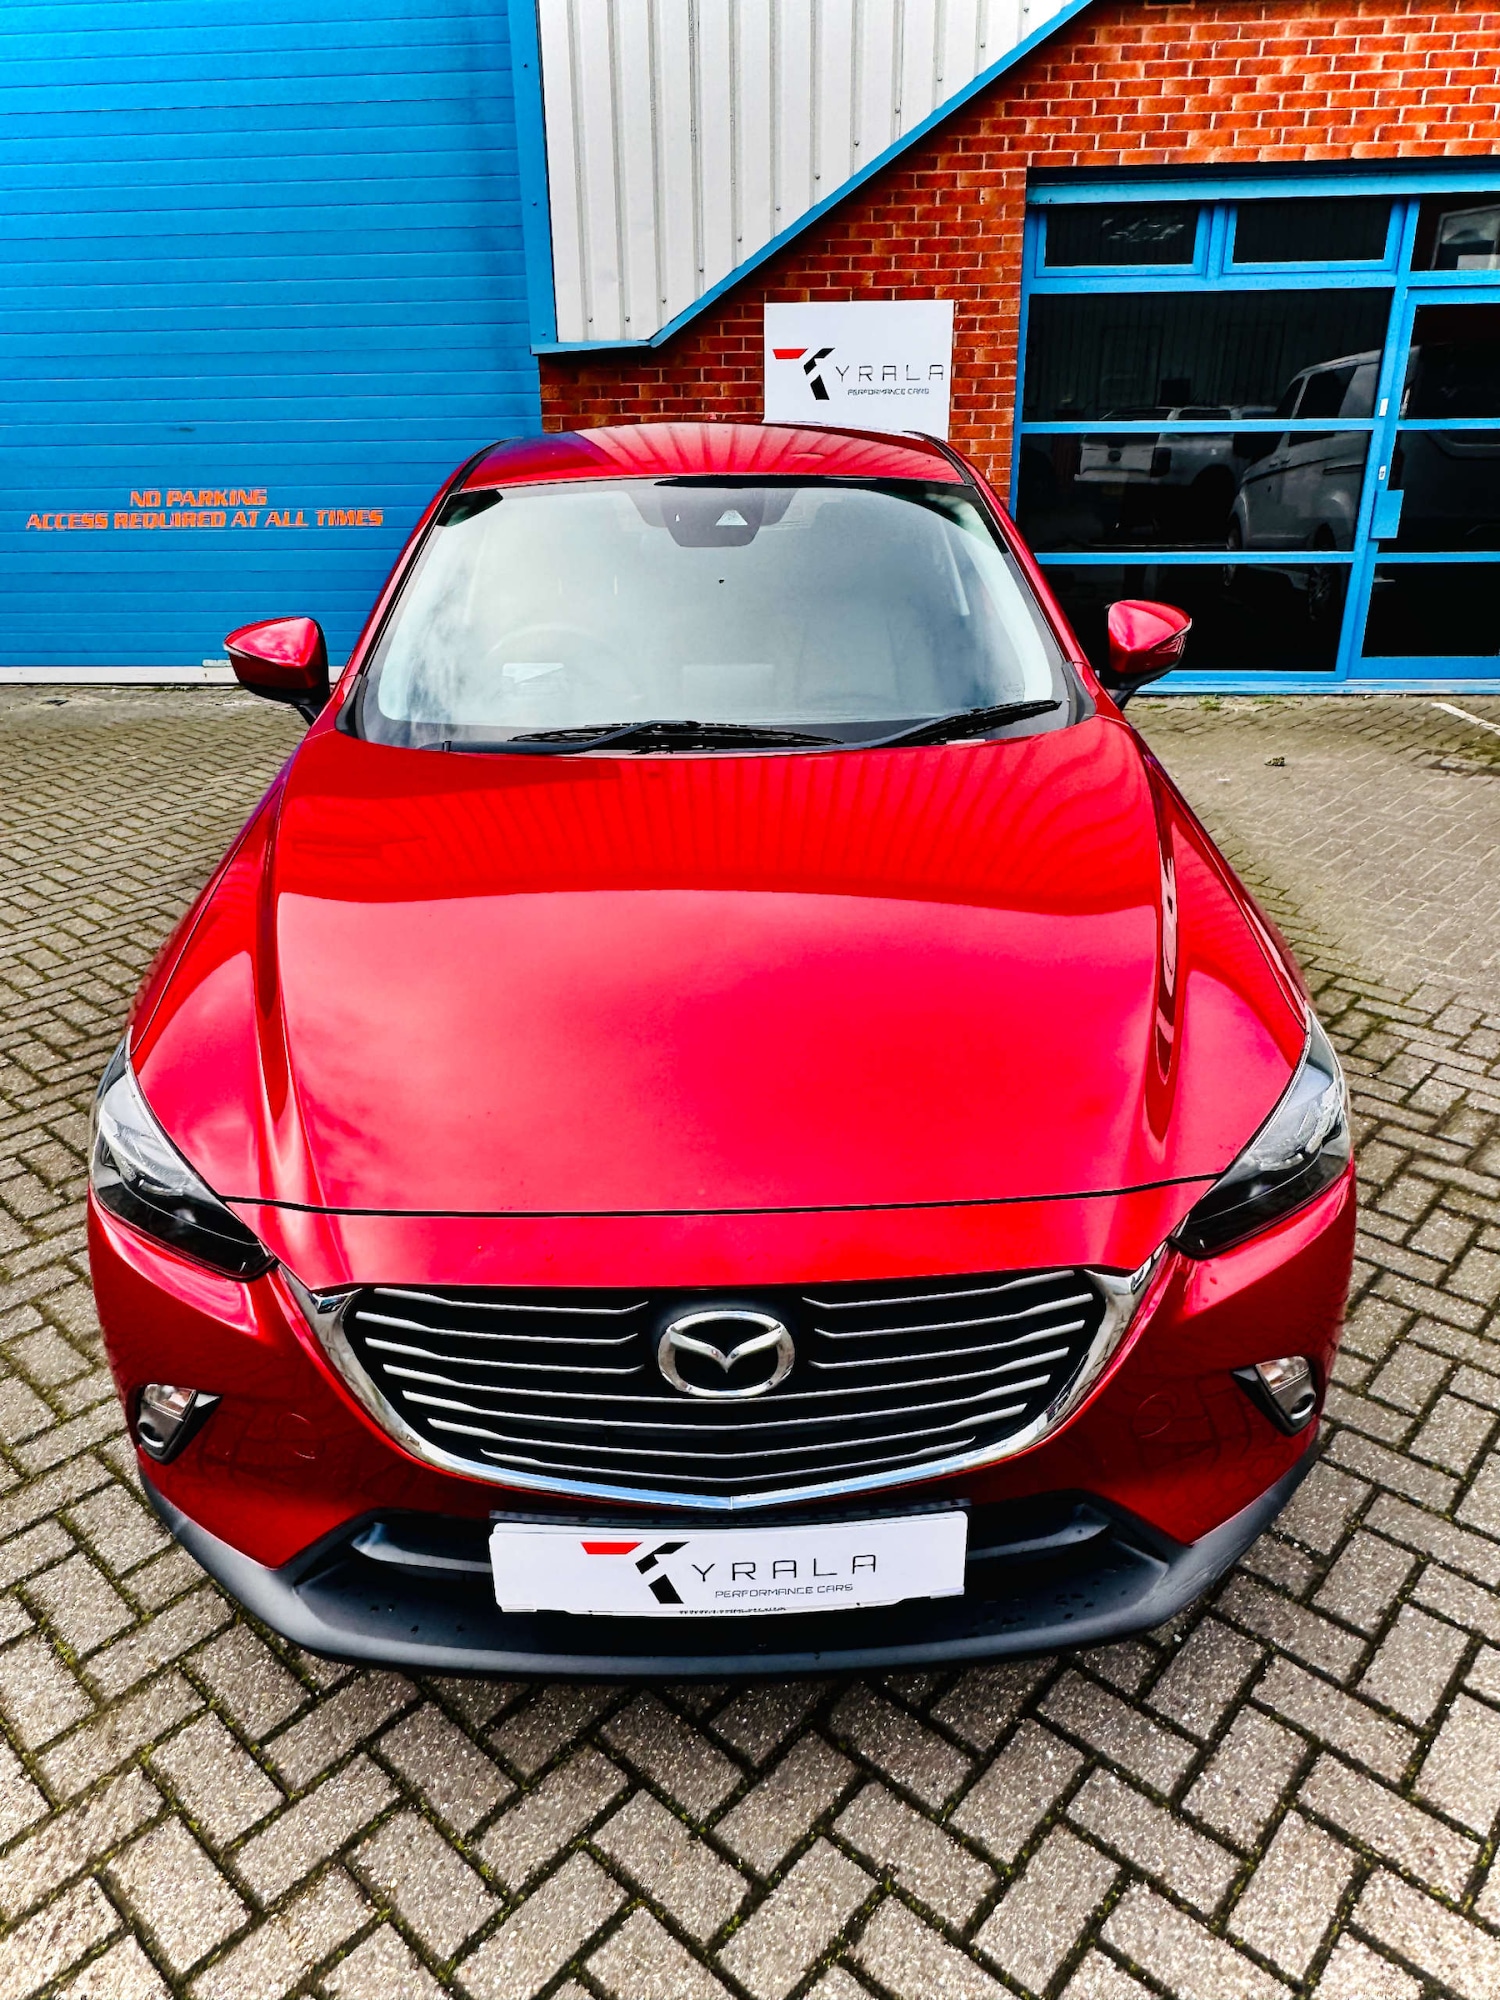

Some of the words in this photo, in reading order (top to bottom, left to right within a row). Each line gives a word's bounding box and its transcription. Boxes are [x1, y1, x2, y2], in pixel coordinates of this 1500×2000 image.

[847, 388, 905, 396] PERFORMANCE
[907, 387, 930, 395] CARS
[130, 489, 161, 507] NO
[166, 488, 268, 507] PARKING
[26, 512, 108, 530] ACCESS
[114, 511, 226, 530] REQUIRED
[231, 510, 261, 528] AT
[264, 510, 308, 528] ALL
[315, 509, 384, 527] TIMES
[714, 1586, 814, 1599] PERFORMANCE
[816, 1583, 854, 1594] CARS
